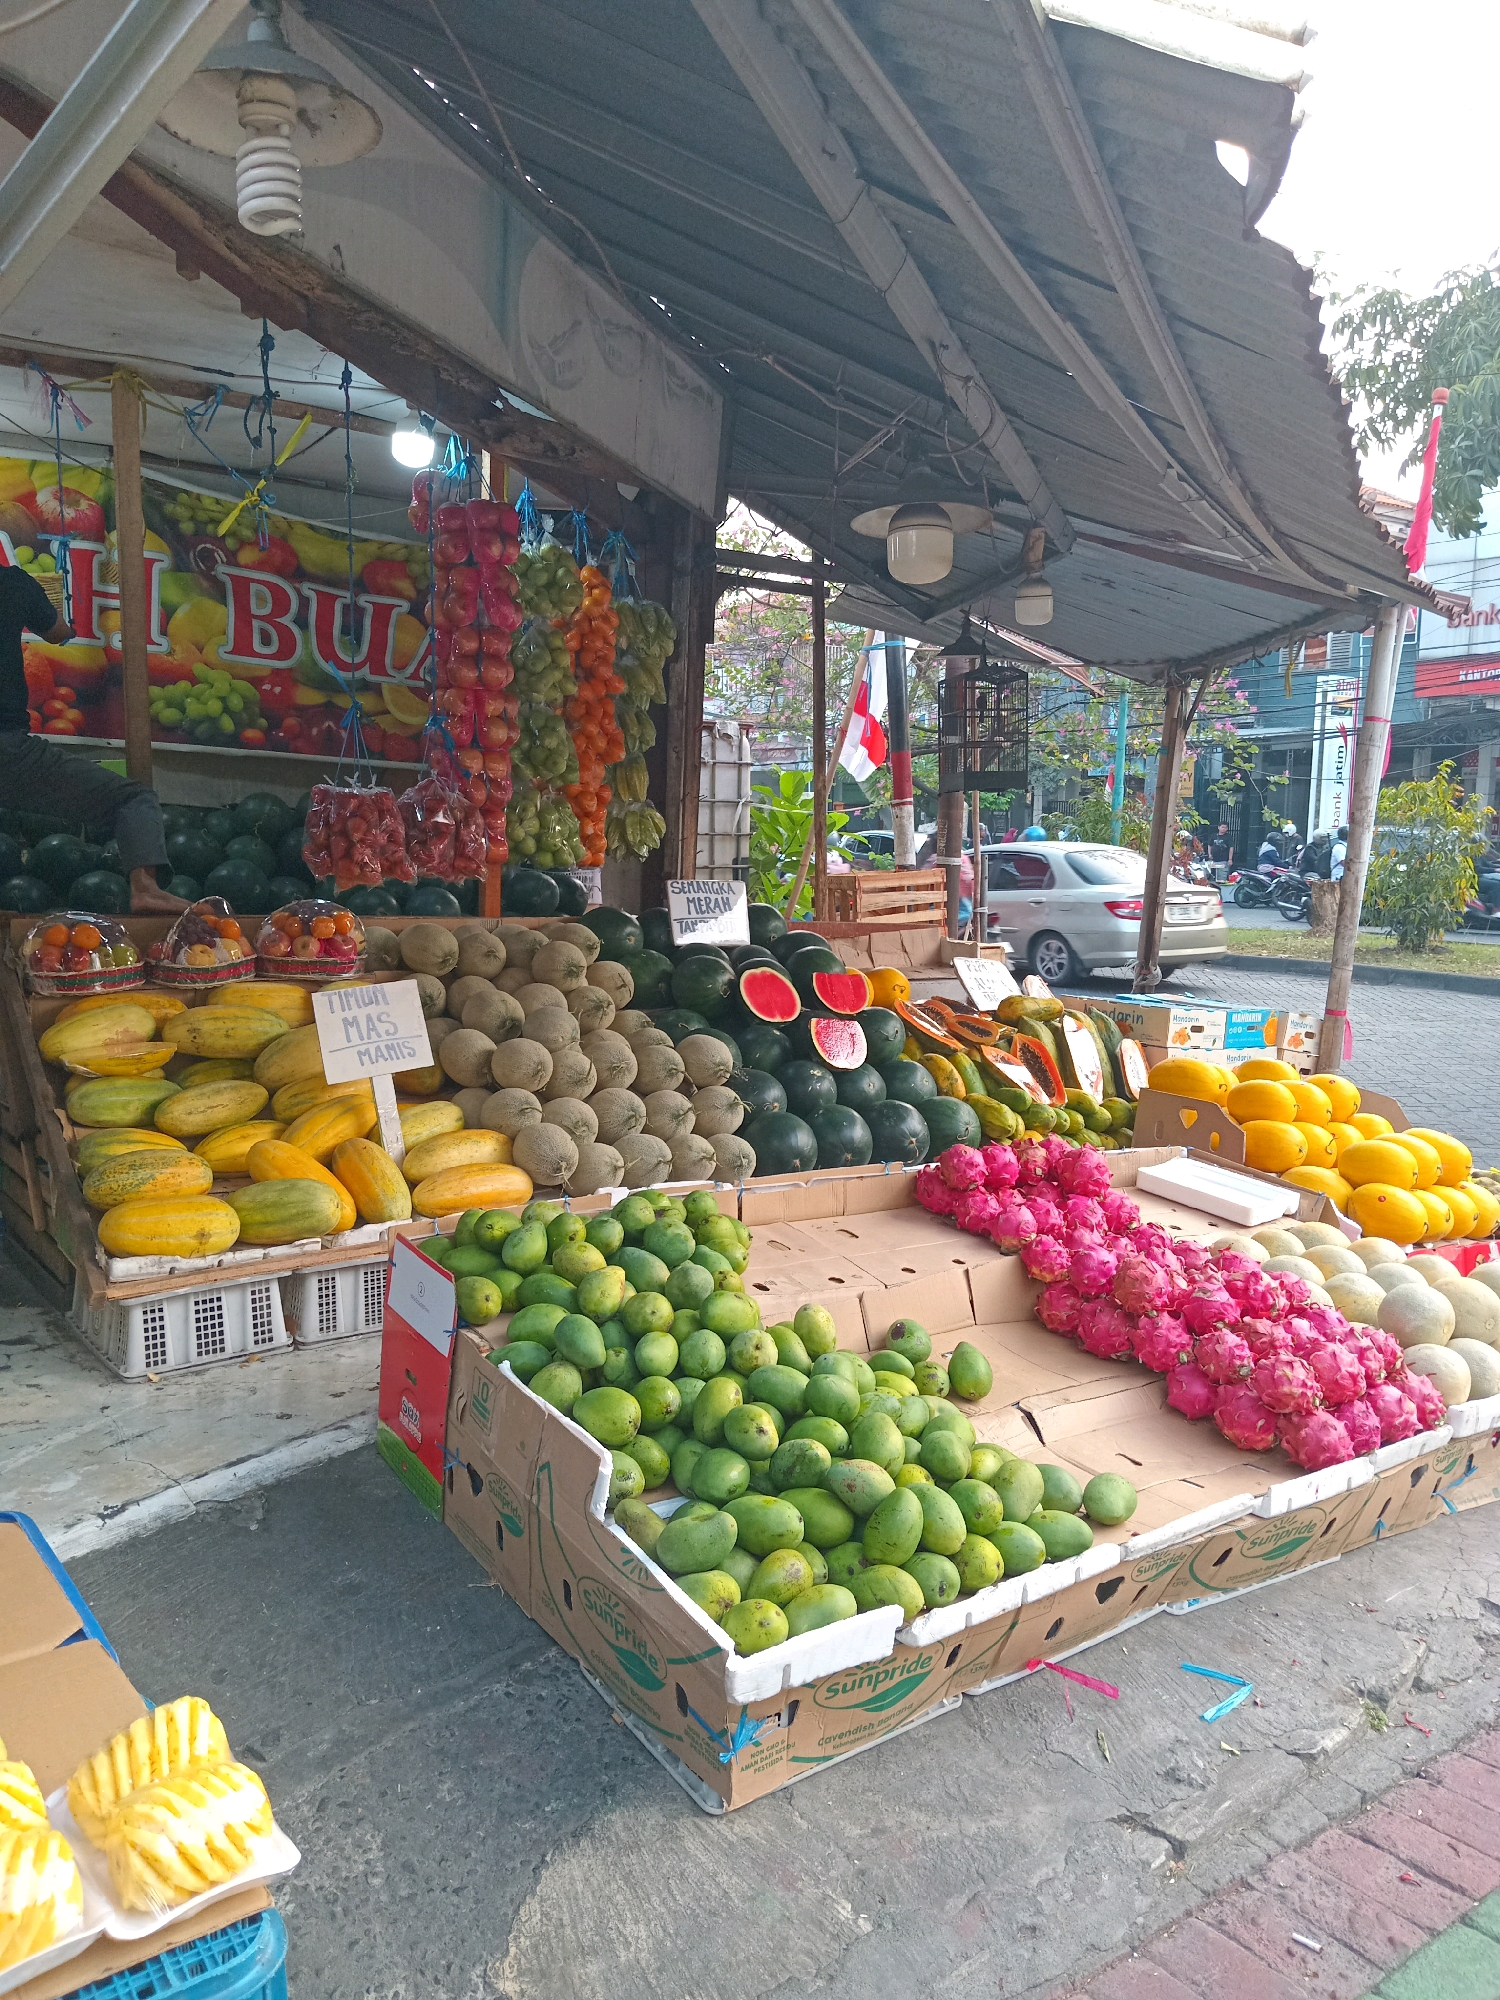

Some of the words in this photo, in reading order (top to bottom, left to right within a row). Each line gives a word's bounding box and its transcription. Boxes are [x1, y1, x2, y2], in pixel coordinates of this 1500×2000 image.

[1333, 745, 1345, 786] jatim
[1331, 791, 1342, 829] bank
[670, 881, 736, 895] SEMANGKA
[686, 897, 732, 915] MERAH
[321, 985, 389, 1014] TIMUN
[341, 1012, 398, 1043] MAS
[1172, 1014, 1200, 1023] Mandarin
[1231, 1012, 1263, 1023] MANDARIN
[1290, 1019, 1314, 1029] Mandarin
[357, 1040, 417, 1066] MANIS
[487, 1479, 522, 1526] Sunpride
[1249, 1519, 1317, 1550] Sunpride
[1136, 1552, 1187, 1577] Sunpride
[583, 1588, 660, 1672] Sunpride
[824, 1652, 934, 1700] Sunpride
[817, 1722, 875, 1747] Cavendish
[877, 1703, 914, 1728] Banana
[740, 1759, 759, 1772] AMAN
[760, 1751, 774, 1764] DARI
[775, 1742, 796, 1755] RESIDU
[750, 1749, 765, 1760] NON
[766, 1741, 780, 1752] GMO
[753, 1755, 784, 1774] PESTISIDA
